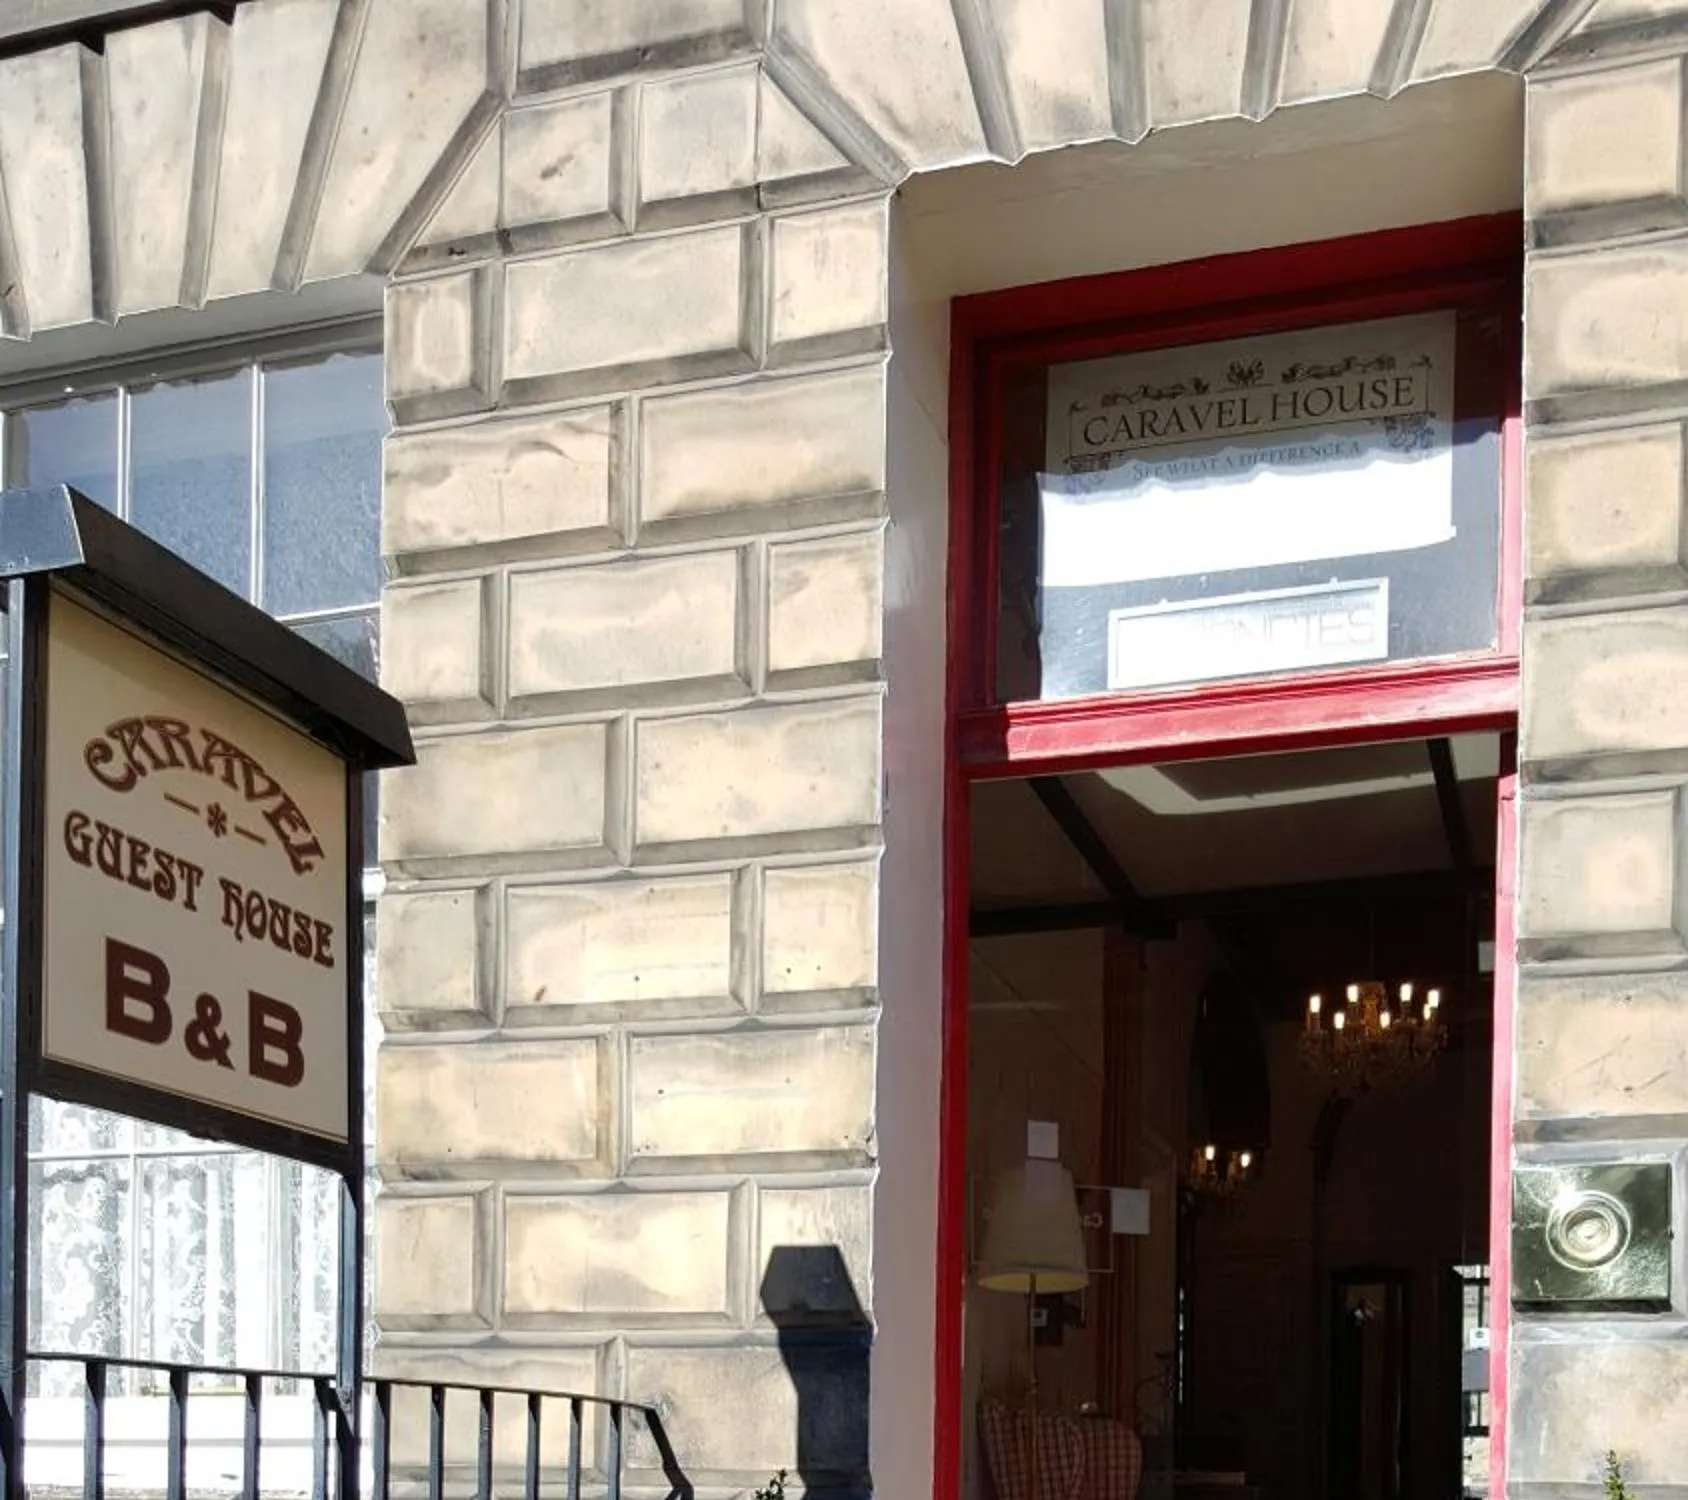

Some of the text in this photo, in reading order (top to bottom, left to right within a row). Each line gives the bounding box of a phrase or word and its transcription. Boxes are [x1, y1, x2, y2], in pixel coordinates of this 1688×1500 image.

[1082, 376, 1415, 448] CARAVEL HOUSE
[1166, 455, 1218, 477] WHAT
[1222, 455, 1235, 470] A
[1239, 441, 1345, 467] DIFFERENCE
[84, 716, 326, 877] CARAVEL
[63, 809, 336, 968] GUEST HOUSE
